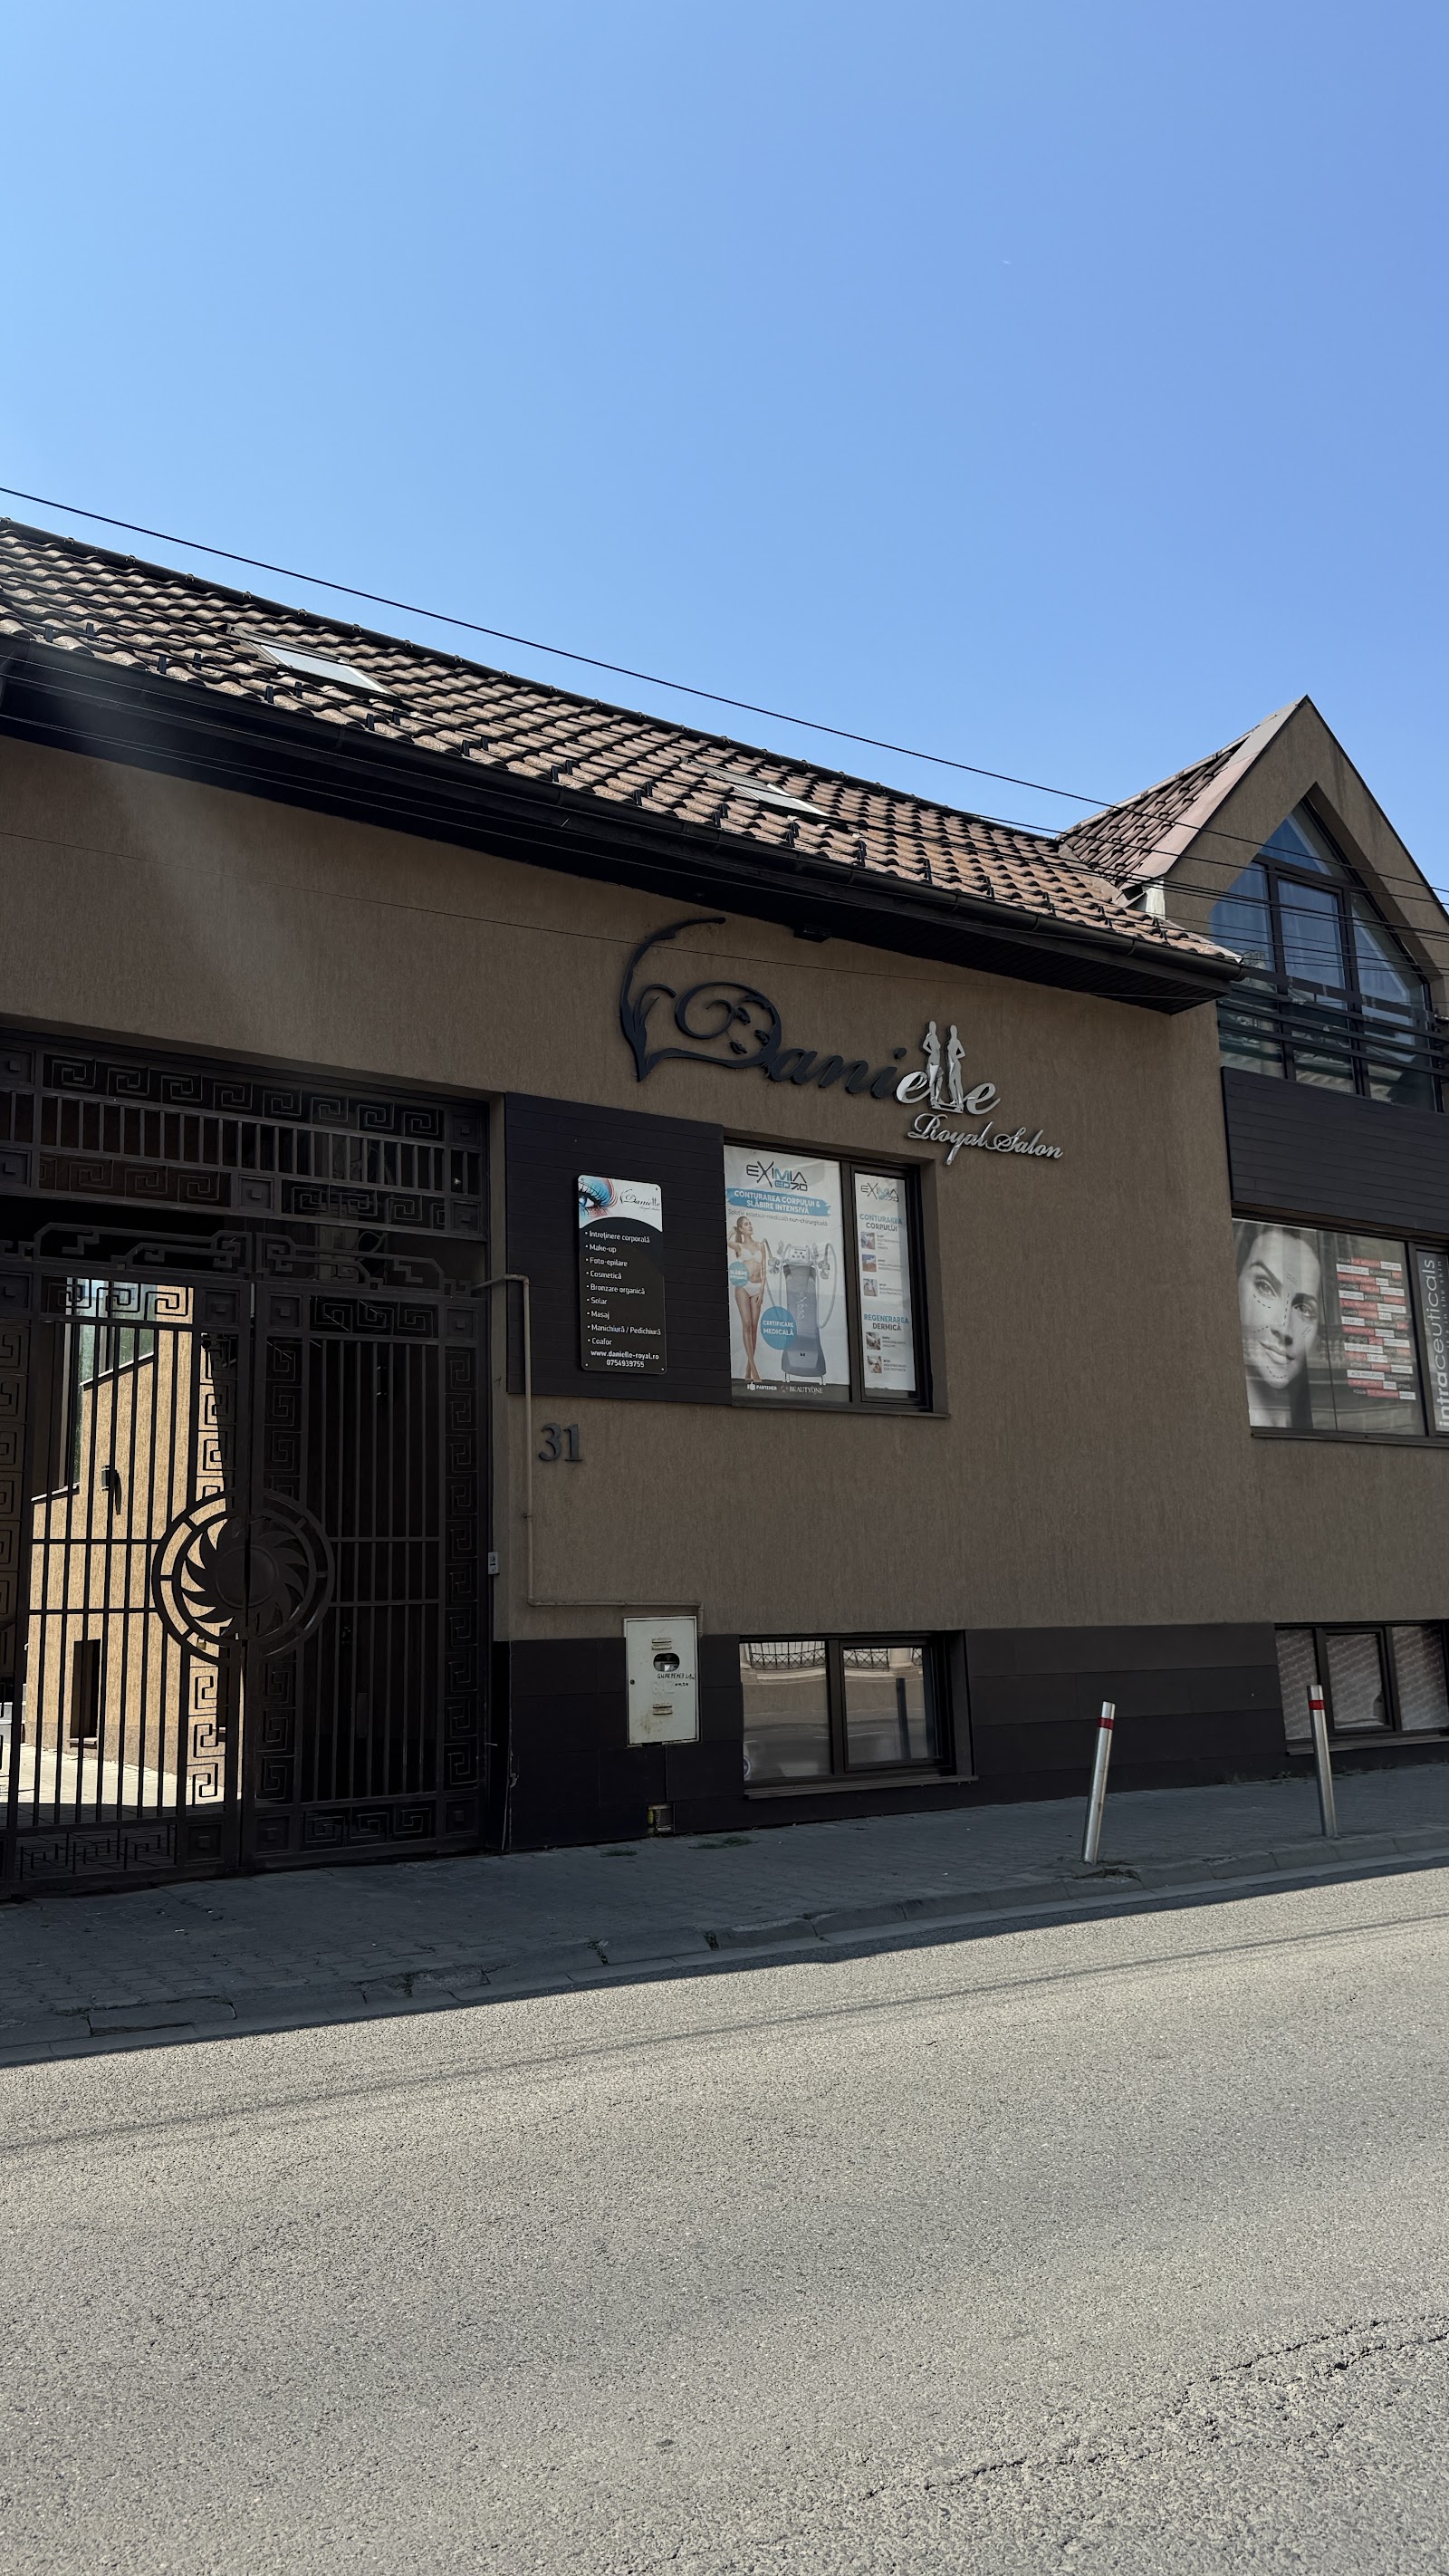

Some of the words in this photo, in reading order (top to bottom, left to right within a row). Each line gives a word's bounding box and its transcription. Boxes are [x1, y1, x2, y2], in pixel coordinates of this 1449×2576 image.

[619, 917, 1002, 1116] Danielle
[907, 1112, 993, 1166] Royal
[986, 1127, 1064, 1159] Salon
[745, 1160, 807, 1188] EXIMIA
[619, 1188, 661, 1206] Danielle
[734, 1189, 781, 1203] CONTURAREA
[782, 1197, 815, 1207] CORPULUI
[746, 1198, 774, 1209] SLĂBIRE
[774, 1203, 810, 1215] INTENSIVĂ
[859, 1213, 903, 1225] CONTURAREA
[866, 1222, 897, 1232] CORPULUI
[621, 1235, 650, 1244] corporală
[589, 1244, 617, 1254] Make-up
[590, 1256, 628, 1267] Foto-epilare
[590, 1270, 622, 1280] Cosmetică
[590, 1283, 619, 1293] Bronzare
[619, 1287, 646, 1295] organică
[590, 1296, 608, 1304] Solar
[590, 1311, 610, 1320] Masaj
[863, 1313, 909, 1324] REGENERAREA
[591, 1323, 625, 1333] Manichiură
[629, 1326, 661, 1335] Pedichiură
[763, 1320, 794, 1328] CERTIFICARE
[872, 1322, 902, 1331] DERMICĂ
[763, 1328, 794, 1336] MEDICALĂ
[591, 1337, 612, 1345] Coafor
[1422, 1259, 1449, 1427] intraceuticals
[590, 1350, 659, 1360] www.danielle-royal.ro
[606, 1360, 645, 1368] 0754939755
[538, 1422, 584, 1462] 31
